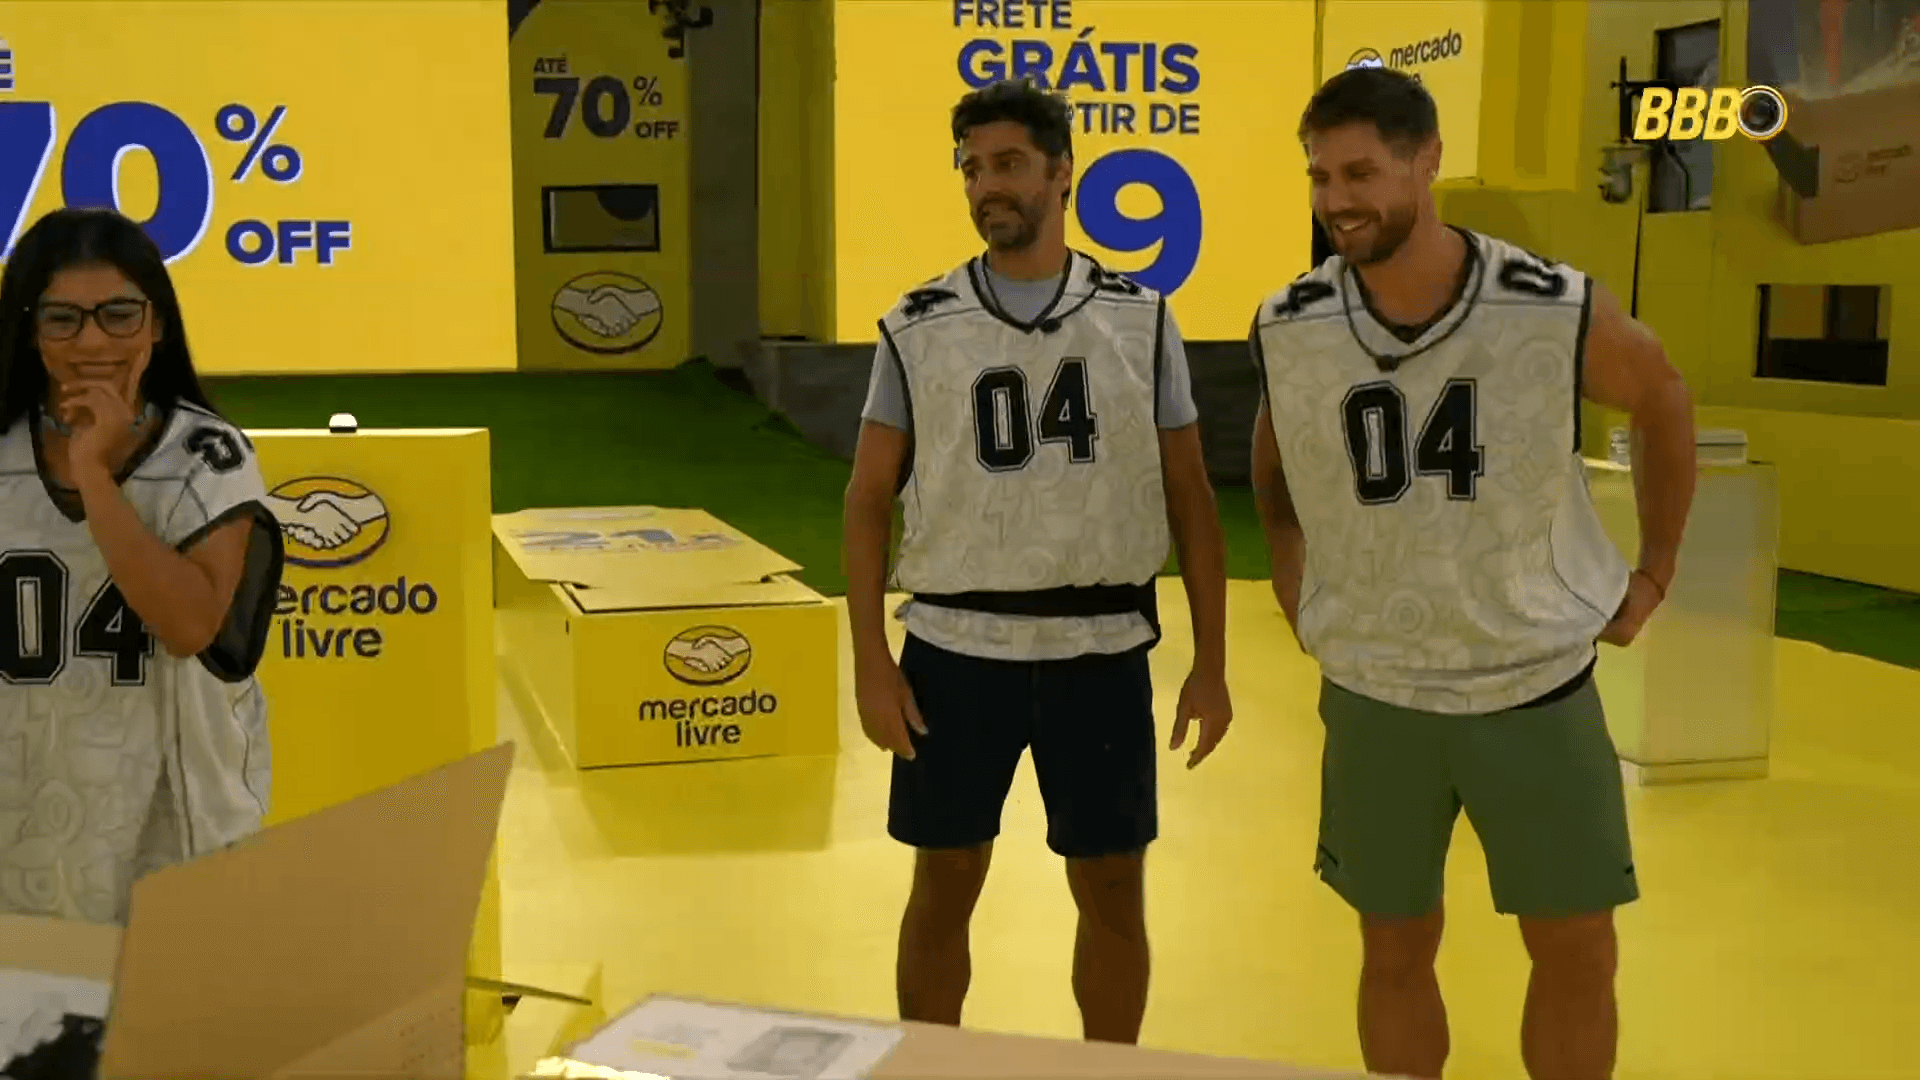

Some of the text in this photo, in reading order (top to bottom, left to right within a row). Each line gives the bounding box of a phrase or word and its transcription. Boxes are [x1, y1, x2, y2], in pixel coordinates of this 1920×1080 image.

[954, 0, 1073, 29] FRETE
[533, 52, 568, 74] ATÉ
[957, 26, 1200, 93] GRÁTIS
[1388, 27, 1463, 68] mercado
[635, 121, 679, 139] OFF
[1149, 103, 1200, 136] DE
[225, 220, 351, 266] OFF
[971, 357, 1099, 473] 04
[1339, 377, 1486, 506] 04
[272, 575, 439, 615] ercado
[0, 548, 155, 687] 04
[282, 617, 383, 659] livre
[638, 688, 778, 721] mercado
[676, 720, 742, 748] livre
